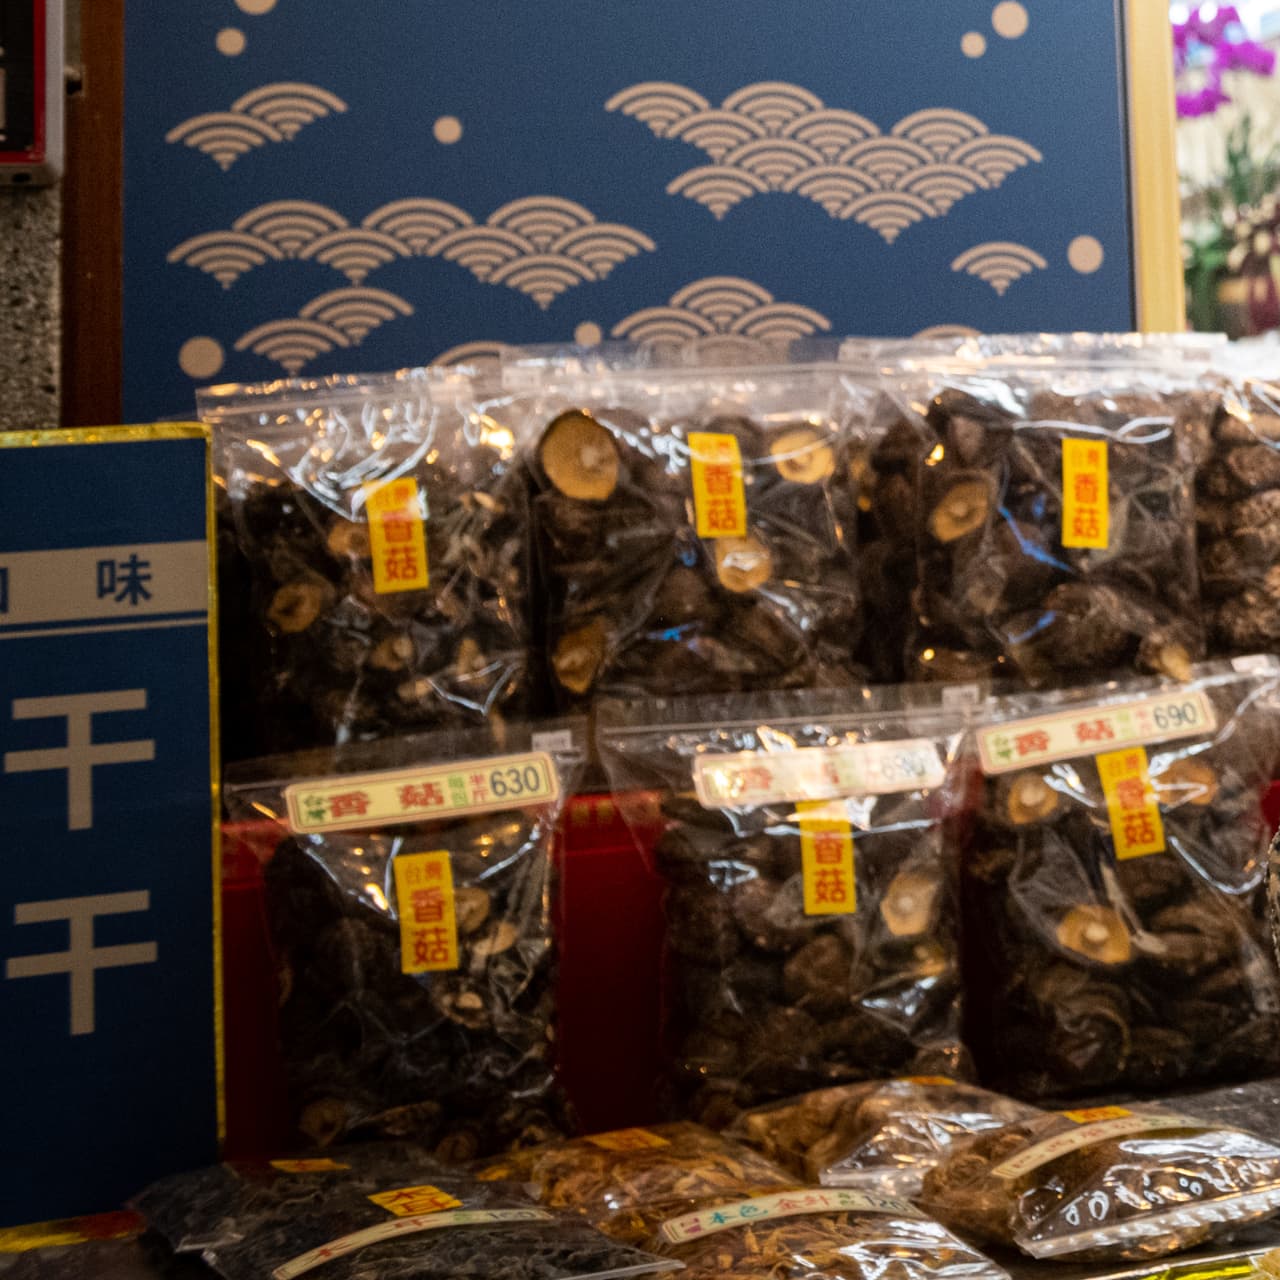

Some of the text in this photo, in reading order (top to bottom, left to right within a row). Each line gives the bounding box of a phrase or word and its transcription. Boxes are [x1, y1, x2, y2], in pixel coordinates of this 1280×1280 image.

[1153, 701, 1197, 730] 690
[490, 765, 541, 798] 630
[411, 886, 449, 966] 香菇
